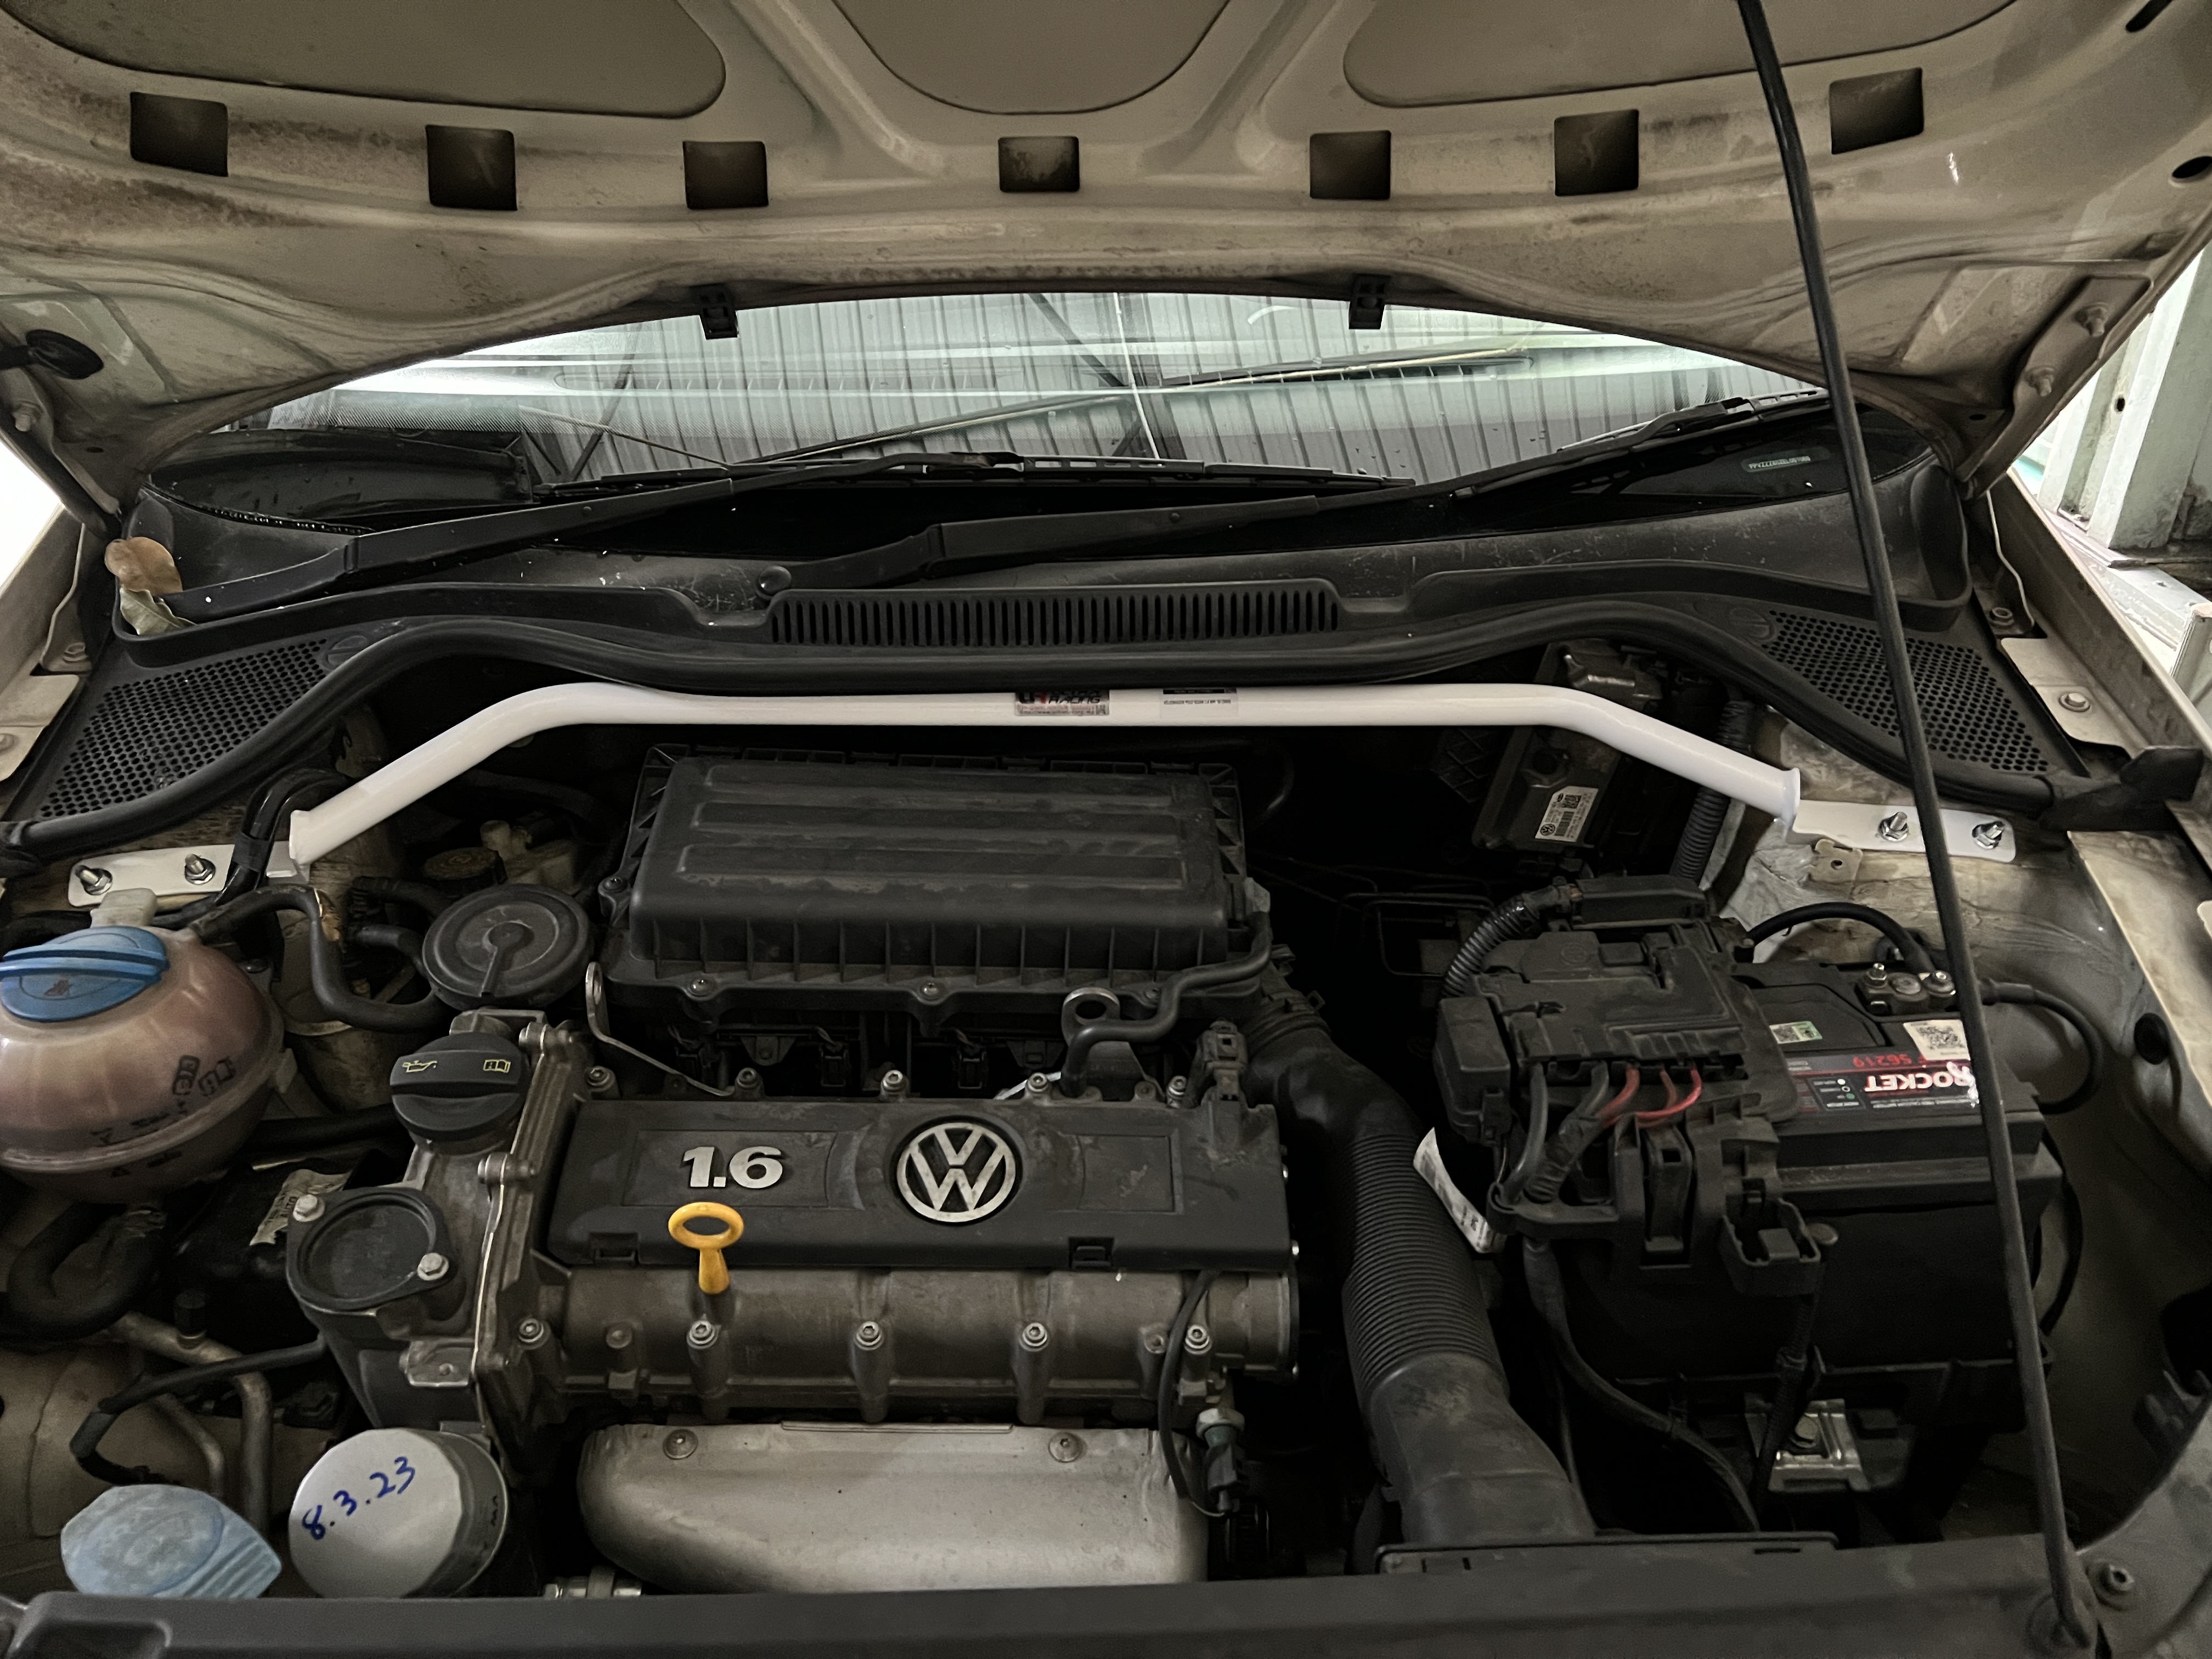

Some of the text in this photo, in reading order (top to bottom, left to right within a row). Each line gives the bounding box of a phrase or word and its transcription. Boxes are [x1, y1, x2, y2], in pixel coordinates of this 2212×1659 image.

[1852, 1053, 1912, 1068] 56219
[682, 1146, 783, 1189] 1.6
[301, 1456, 416, 1541] 8.3.23
